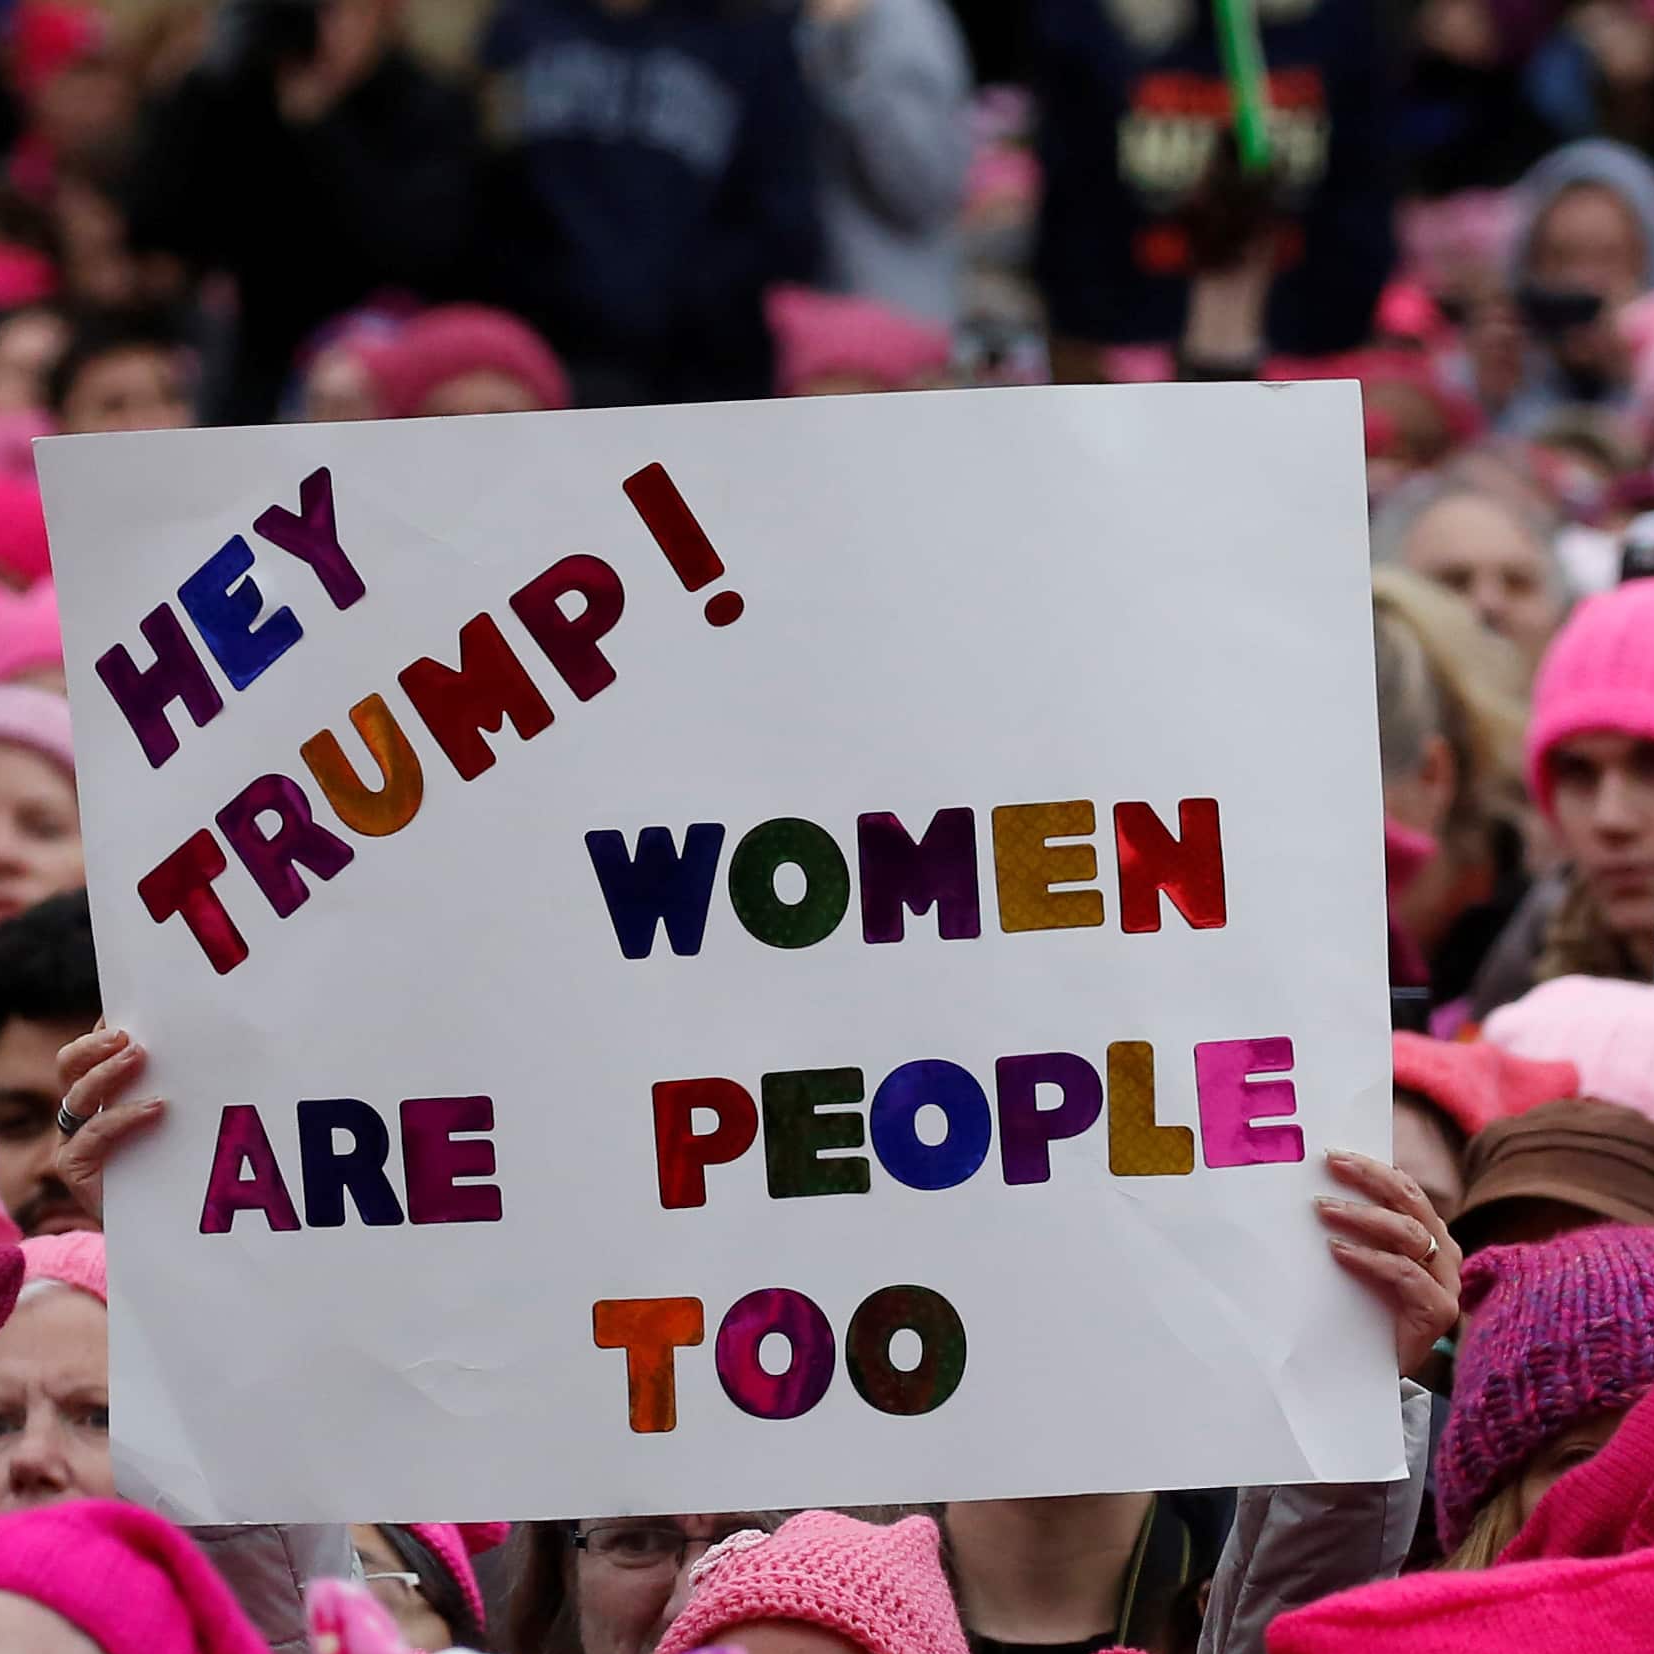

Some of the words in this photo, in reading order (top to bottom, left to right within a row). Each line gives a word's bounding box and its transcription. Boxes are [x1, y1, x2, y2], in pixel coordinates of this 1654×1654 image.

[95, 466, 366, 769] HEY
[136, 462, 745, 976] TRUMP!
[584, 798, 1227, 960] WOMEN
[198, 1096, 503, 1235] ARE
[652, 1036, 1305, 1209] PEOPLE
[592, 1285, 967, 1434] TOO
